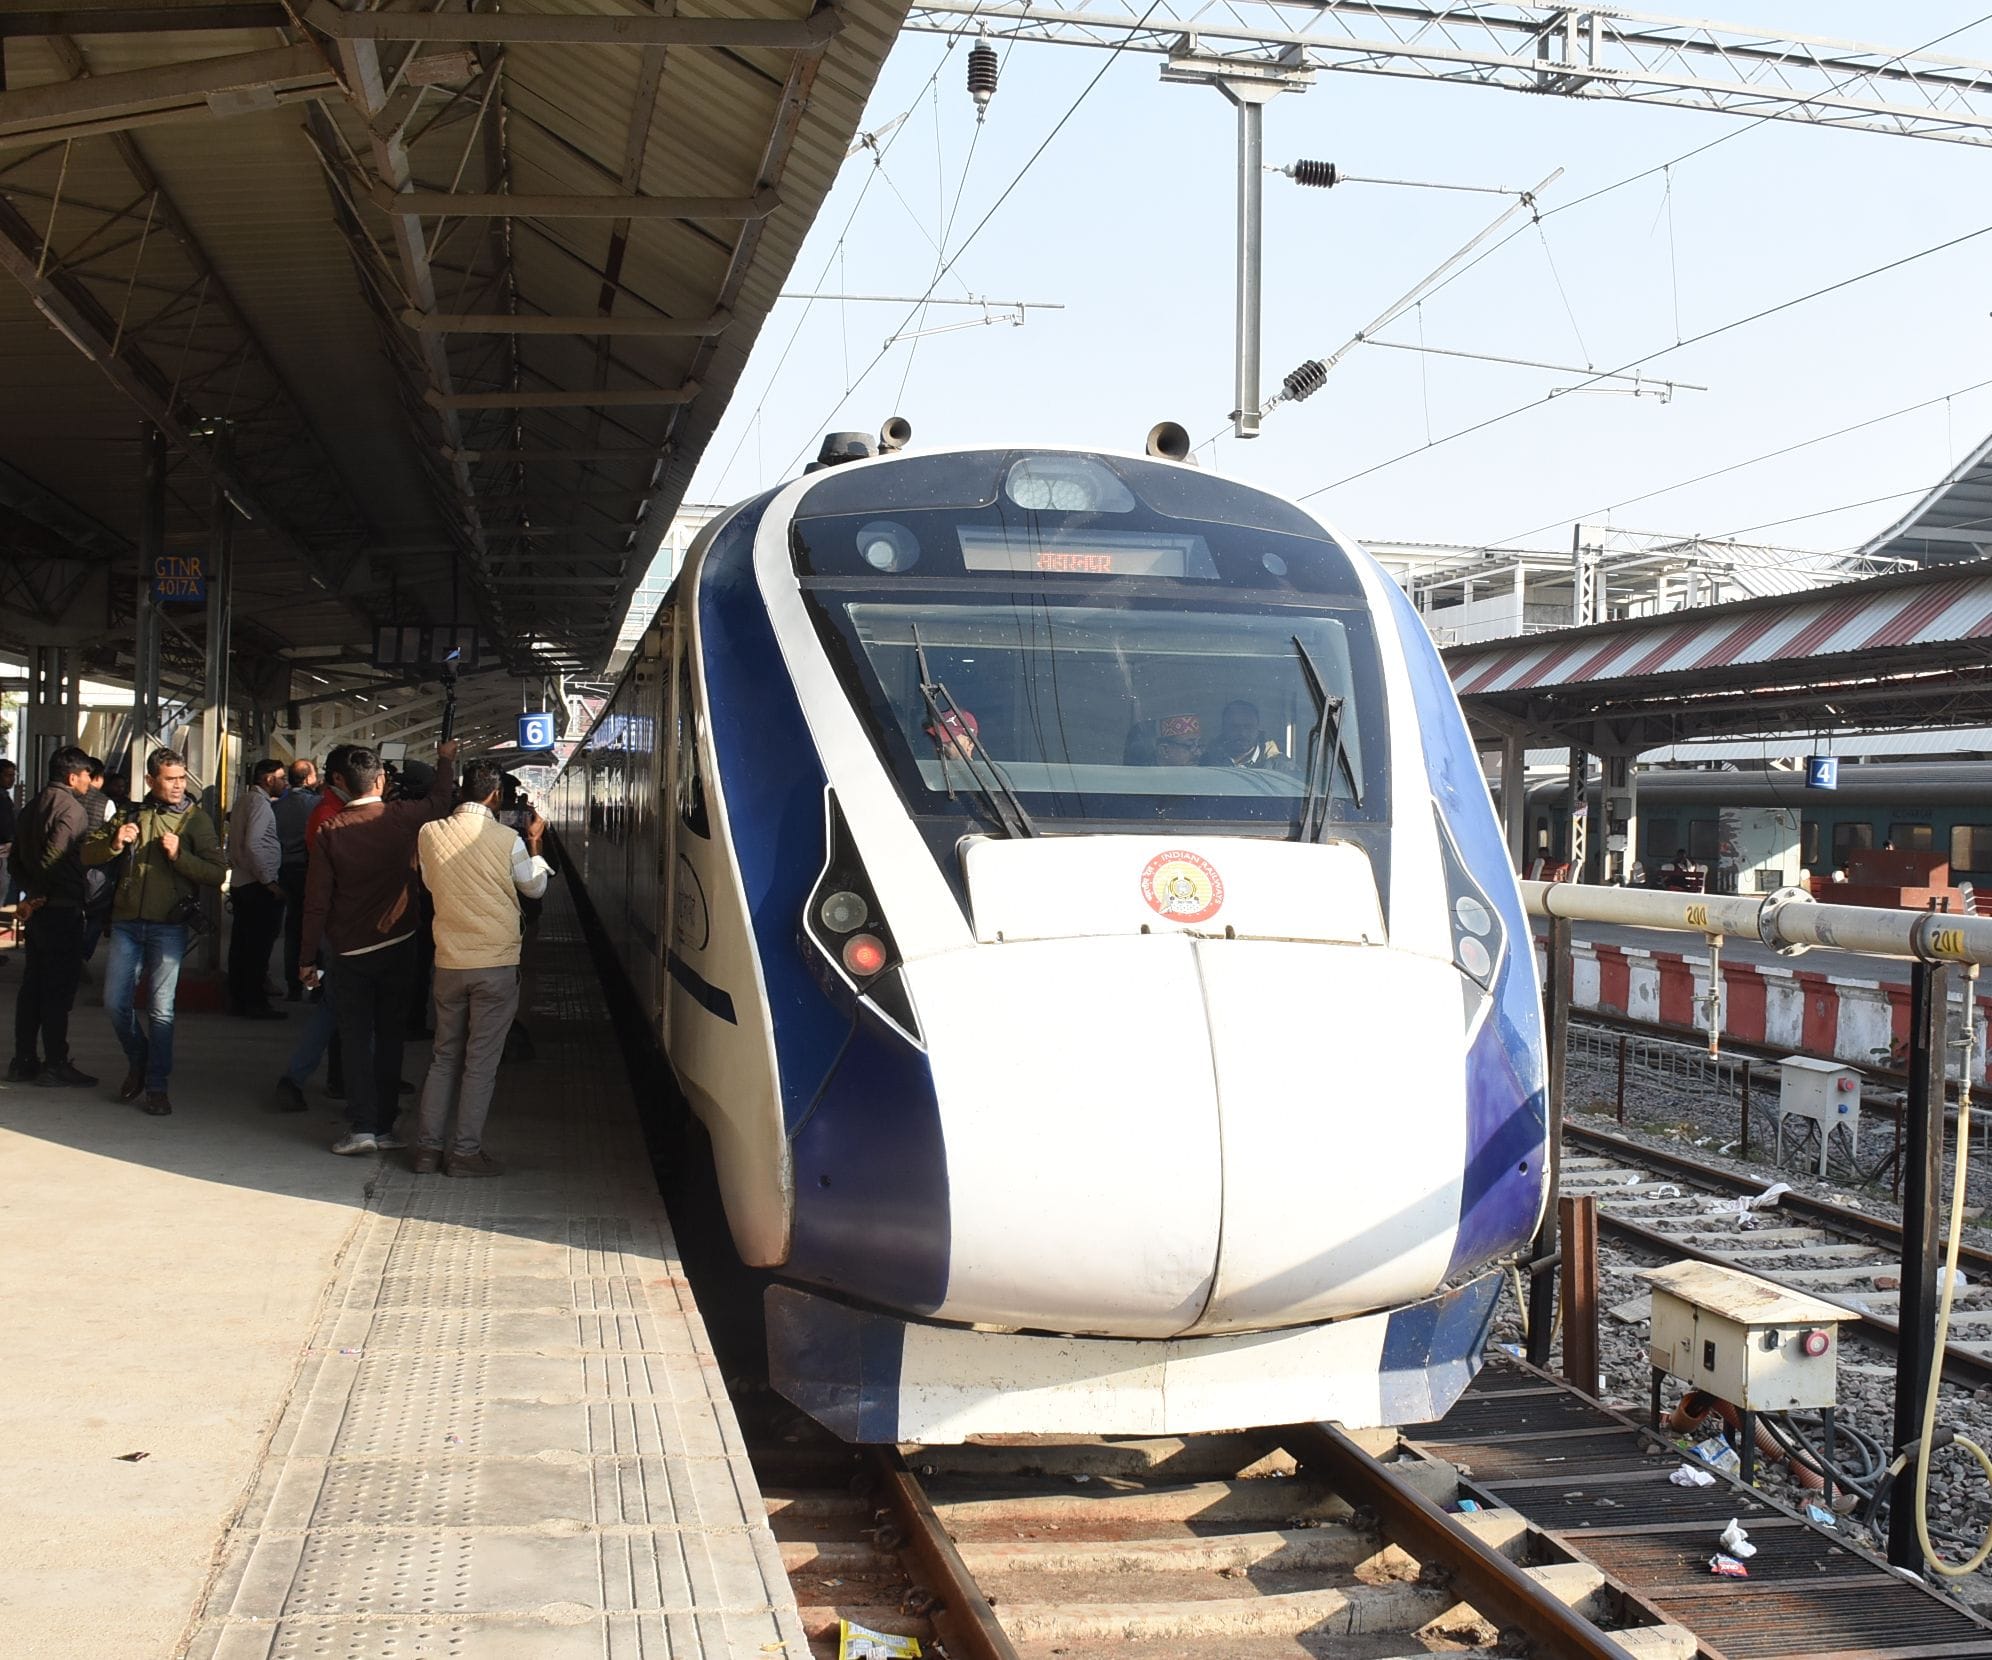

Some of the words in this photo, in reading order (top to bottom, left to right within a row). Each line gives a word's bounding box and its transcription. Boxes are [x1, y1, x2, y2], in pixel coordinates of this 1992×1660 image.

[155, 556, 202, 577] GTNR
[158, 580, 200, 596] 4017A
[526, 720, 544, 744] 6
[1817, 763, 1830, 782] 4
[1160, 851, 1200, 862] INDIAN
[1202, 861, 1224, 905] RAILWAYS
[1686, 905, 1707, 925] 200
[1933, 930, 1959, 953] 201
